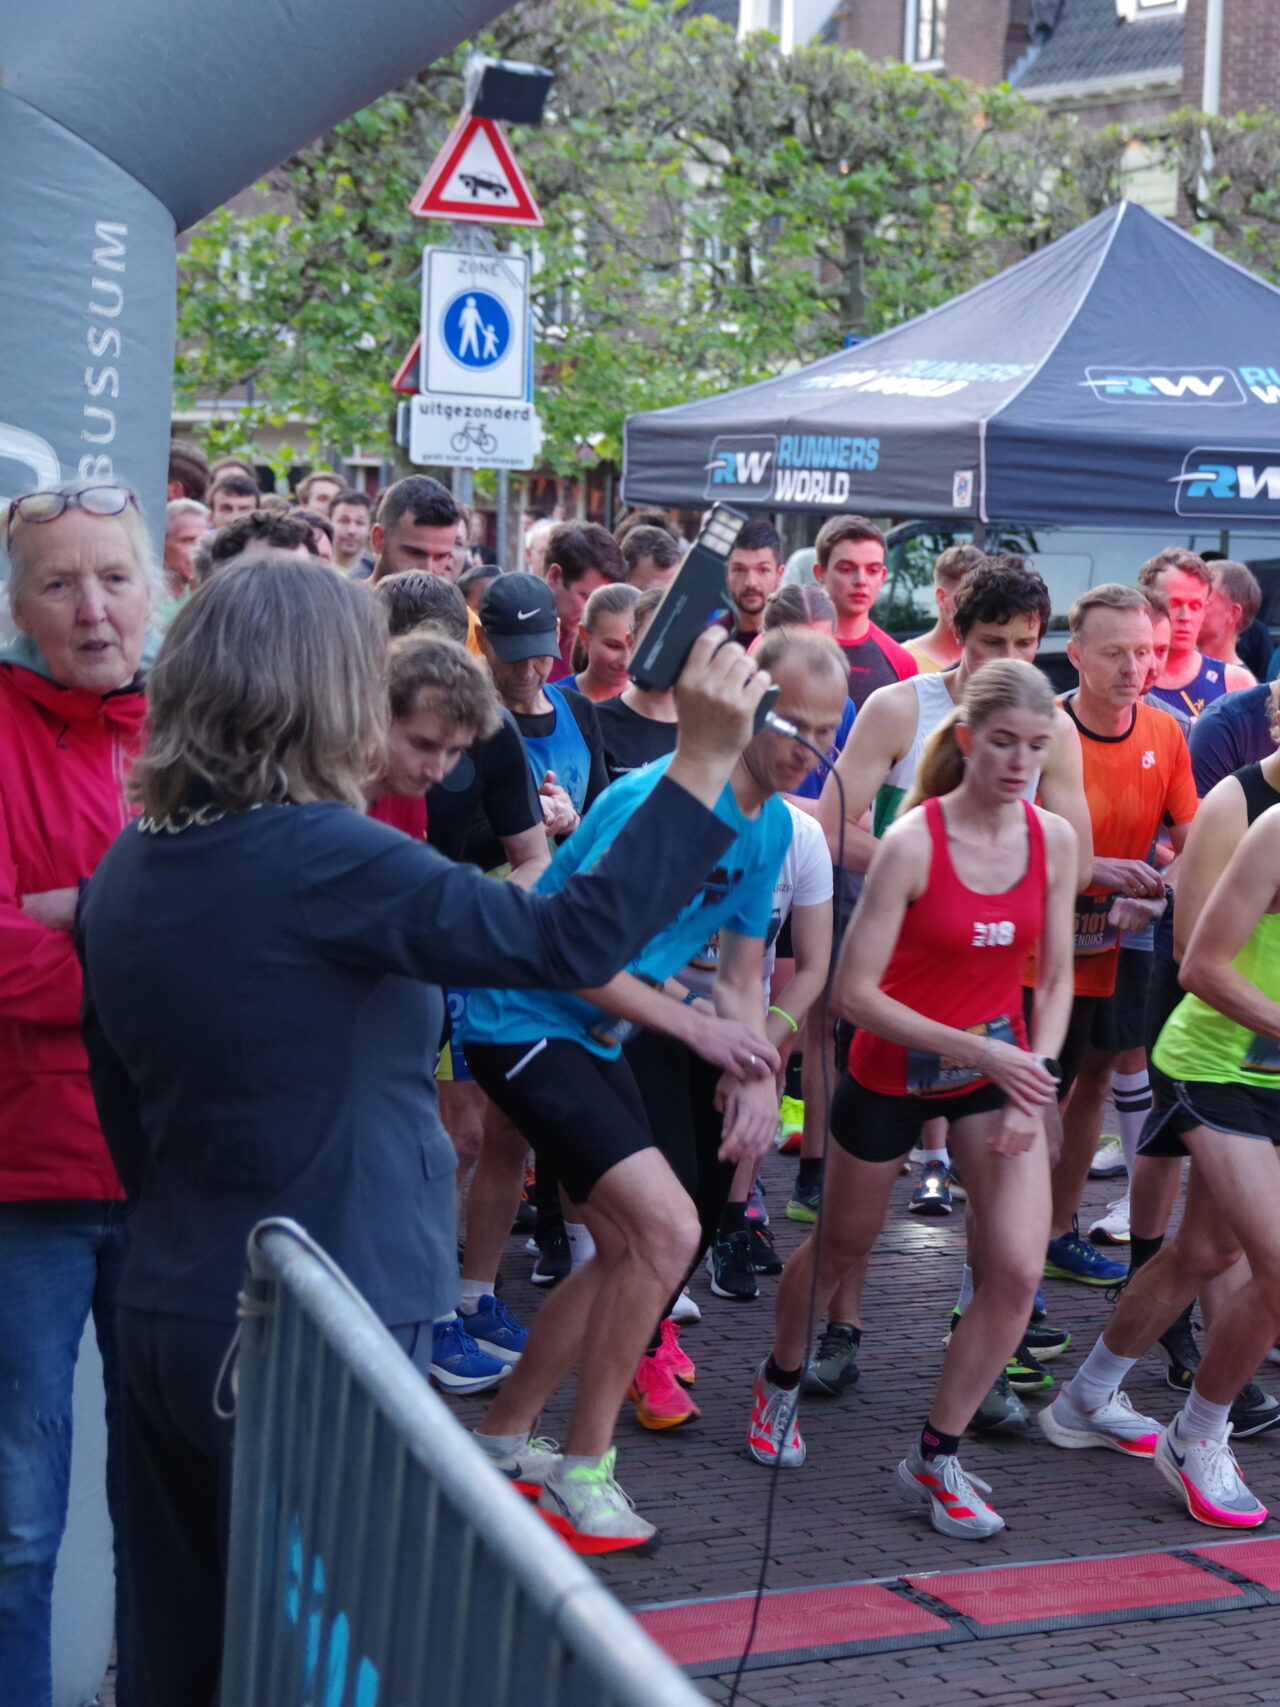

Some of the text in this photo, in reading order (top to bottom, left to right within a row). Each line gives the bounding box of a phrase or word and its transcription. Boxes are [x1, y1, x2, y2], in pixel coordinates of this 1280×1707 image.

[456, 260, 501, 277] ZONE
[1098, 375, 1225, 397] RW
[418, 402, 531, 422] uitgezonderd
[777, 434, 881, 471] RUNNERS
[708, 451, 772, 484] RW
[774, 470, 850, 504] WORLD
